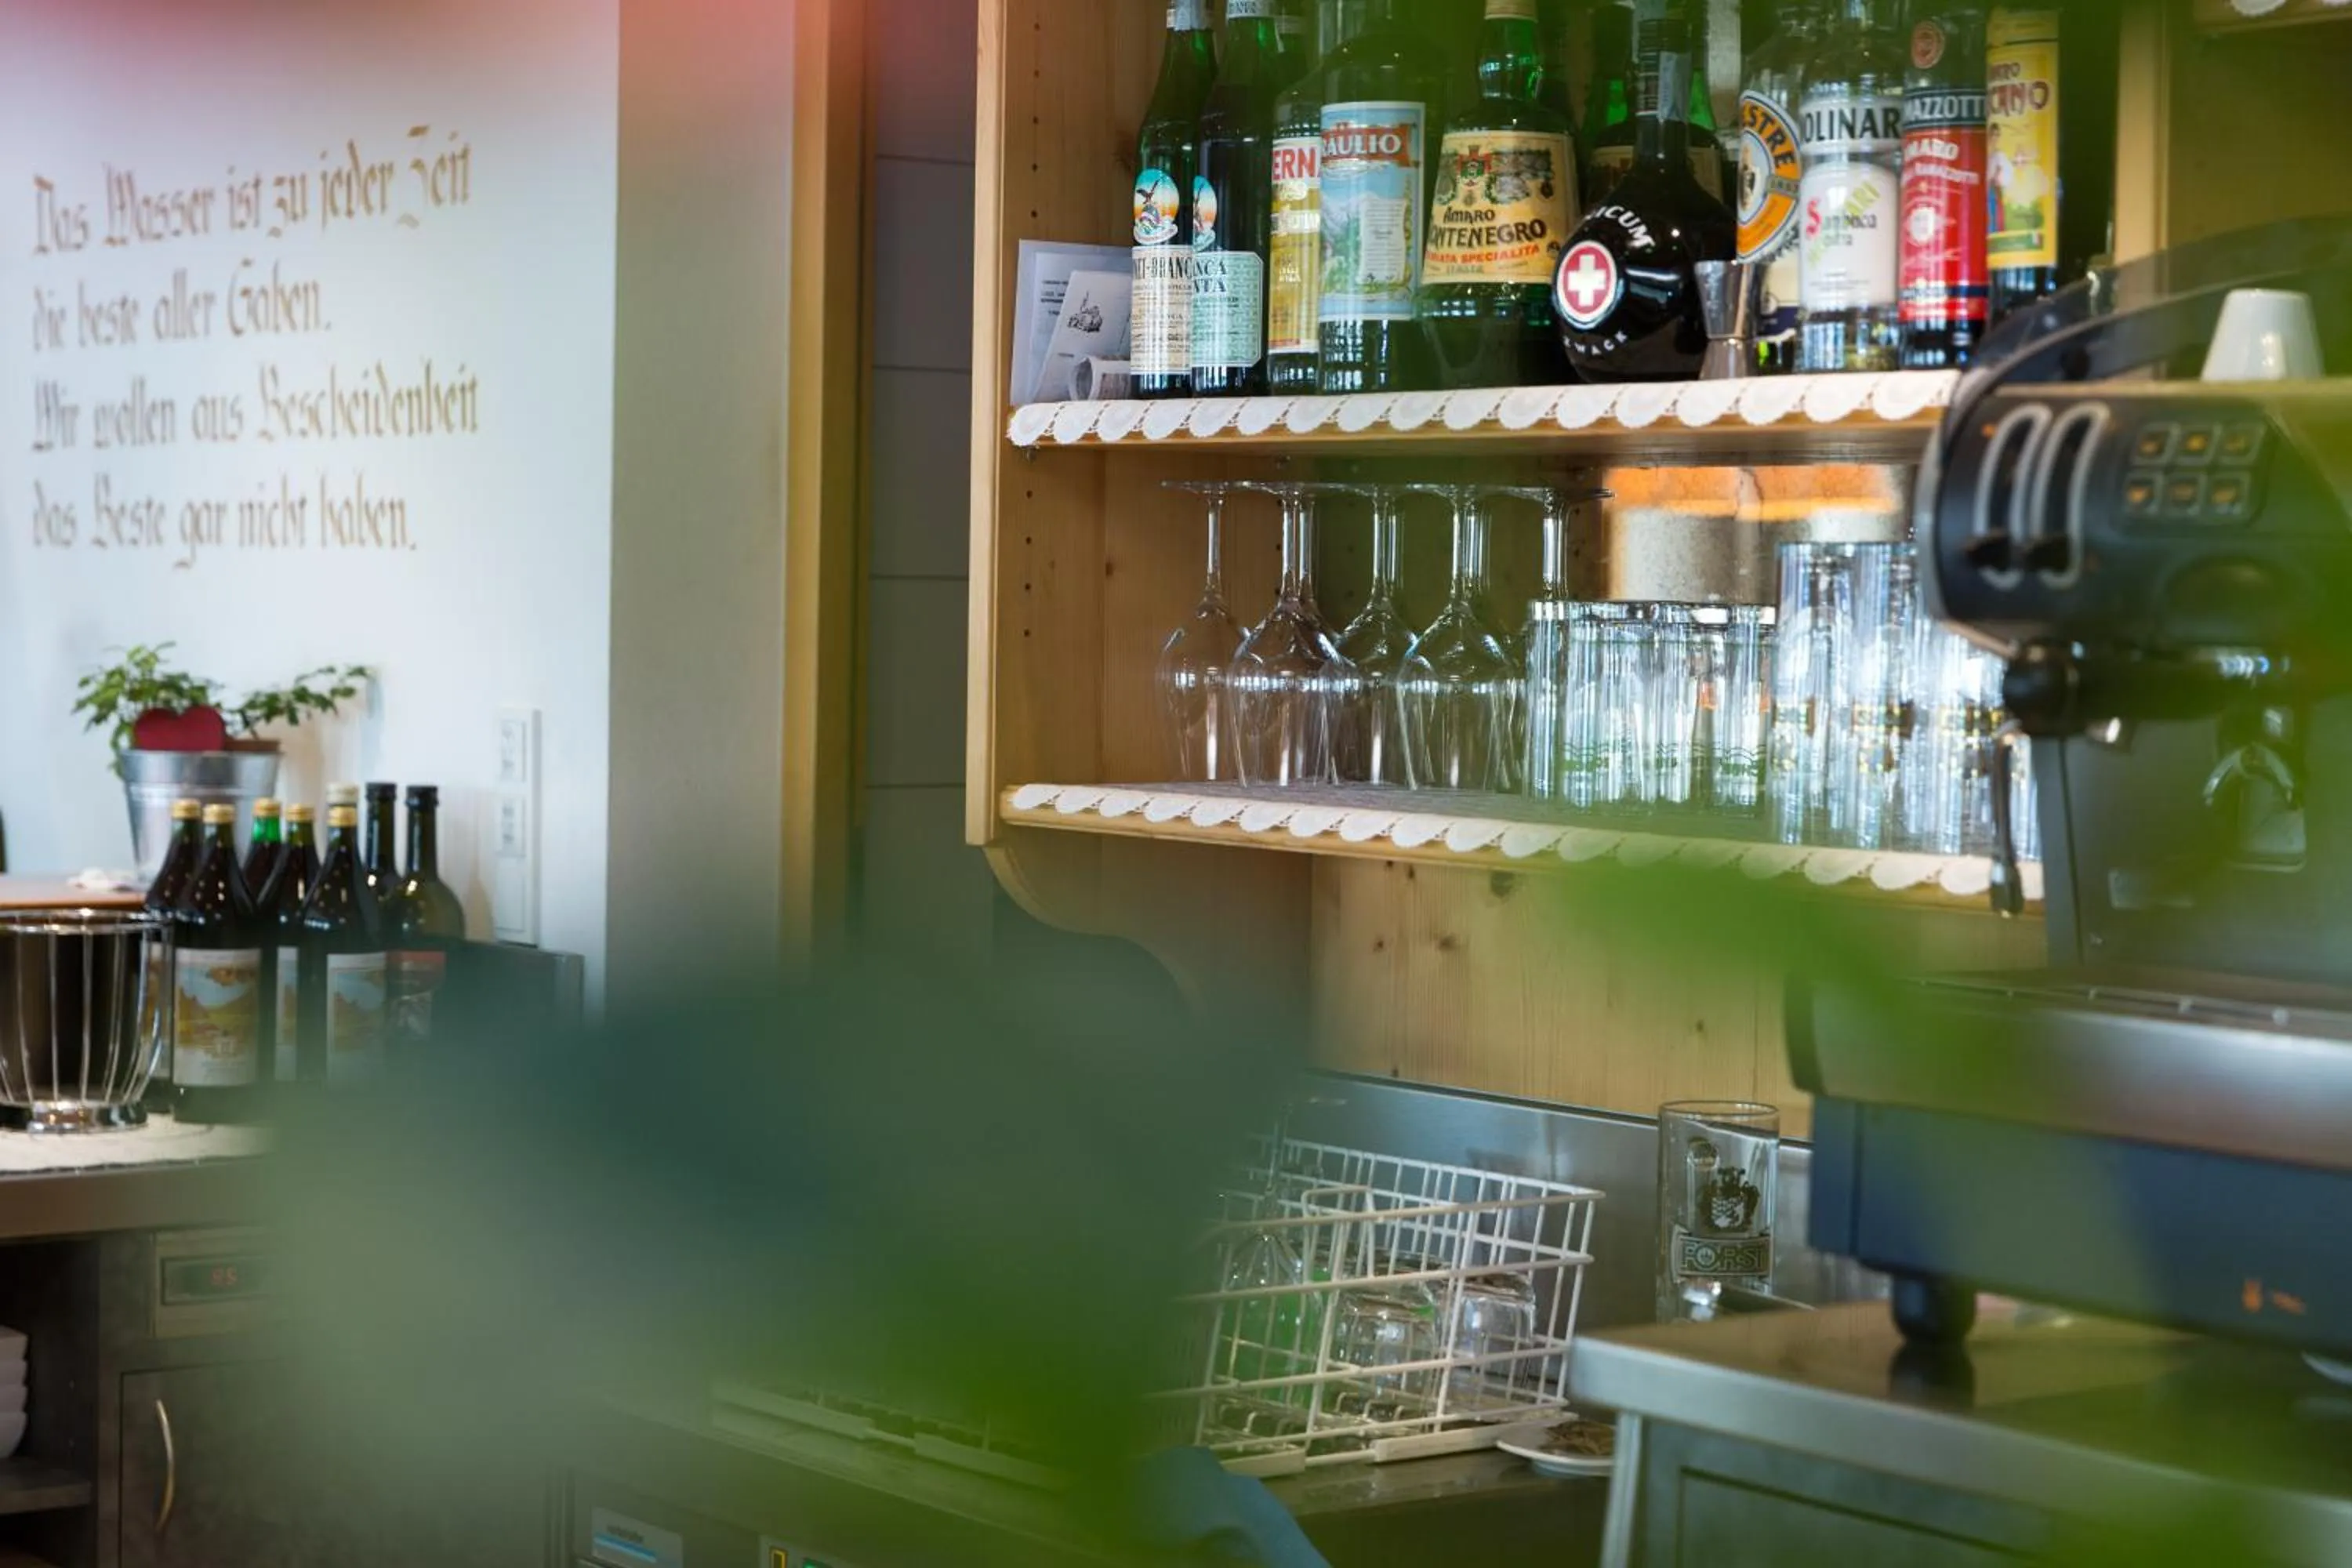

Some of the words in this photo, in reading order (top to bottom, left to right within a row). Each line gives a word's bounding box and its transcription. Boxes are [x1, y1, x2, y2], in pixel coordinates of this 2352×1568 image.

[34, 175, 89, 255] Das
[103, 162, 215, 245] Wasser
[226, 164, 261, 230] ist
[268, 175, 308, 238] zu
[321, 138, 394, 230] jeder
[396, 124, 471, 228] Zeit
[1272, 147, 1321, 180] ERN
[33, 284, 67, 353] die
[78, 278, 140, 349] beste
[154, 268, 216, 341] aller
[227, 257, 332, 337] Gaben.
[32, 376, 81, 452] Wir
[93, 374, 177, 449] wollen
[191, 393, 244, 443] aus
[257, 357, 478, 443] Bescheidenheit
[33, 477, 78, 549] das
[91, 470, 165, 550] Beste
[173, 496, 227, 570] gar
[238, 471, 307, 548] nicht
[321, 468, 417, 551] haben.
[1682, 1241, 1764, 1272] FORST
